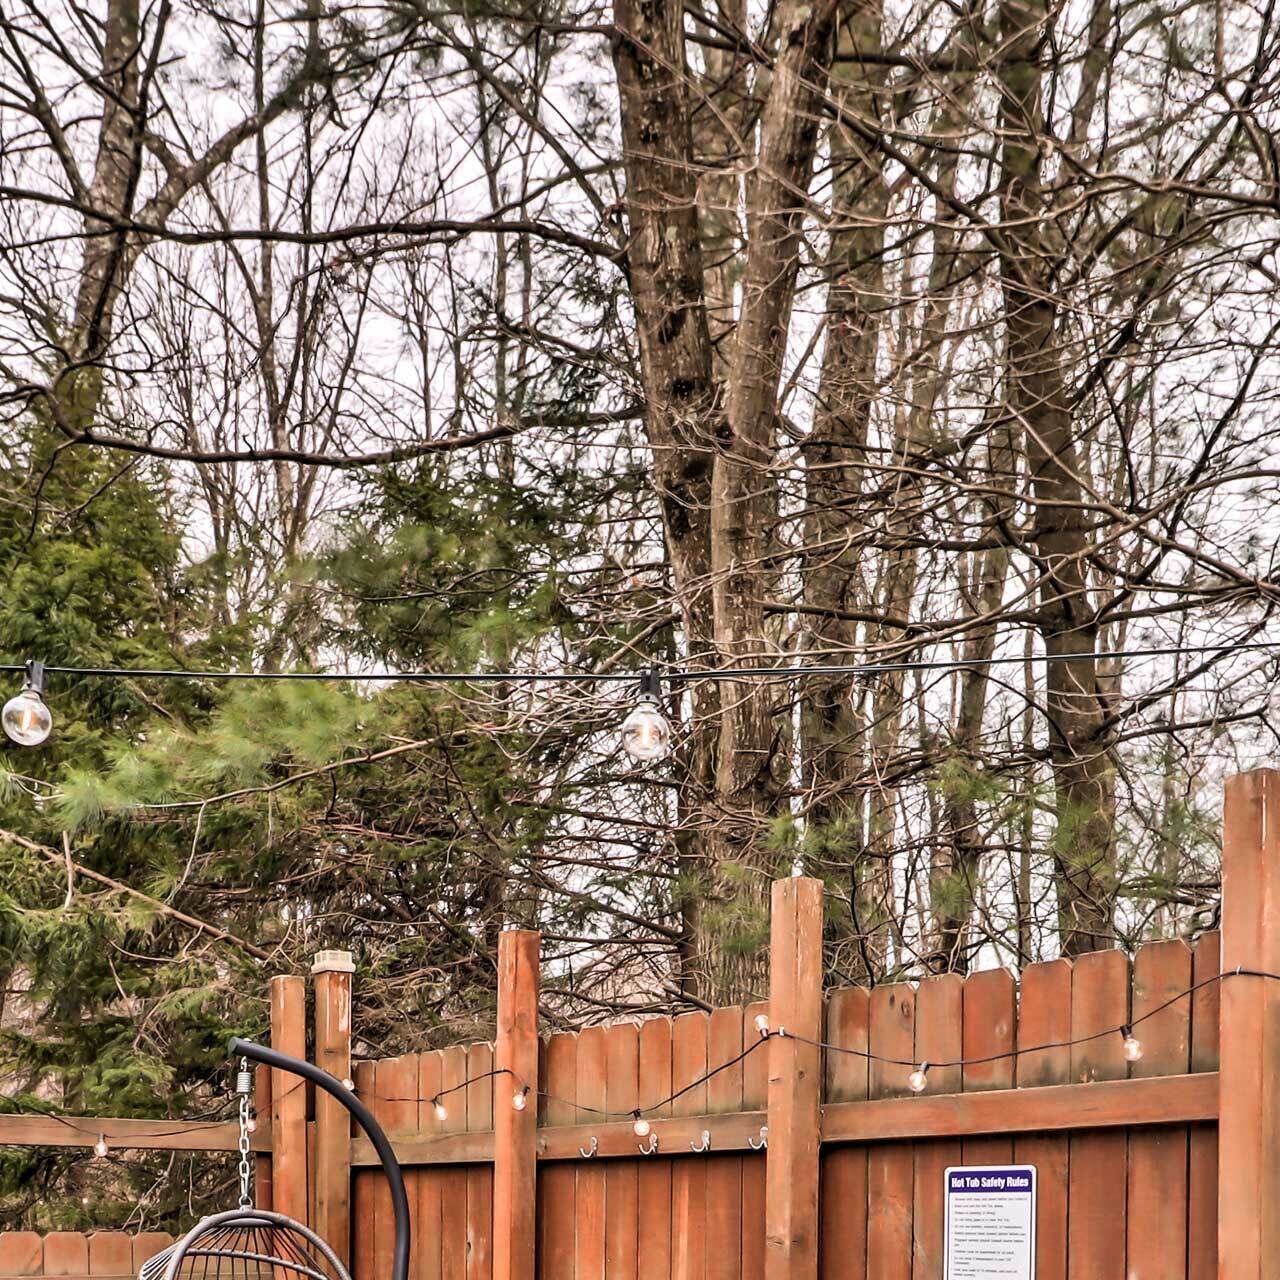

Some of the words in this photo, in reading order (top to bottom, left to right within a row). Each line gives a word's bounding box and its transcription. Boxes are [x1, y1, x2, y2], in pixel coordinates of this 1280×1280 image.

[951, 1177, 965, 1188] Hot
[965, 1177, 980, 1188] Tub
[981, 1176, 1005, 1189] Safety
[1006, 1176, 1029, 1187] Rules
